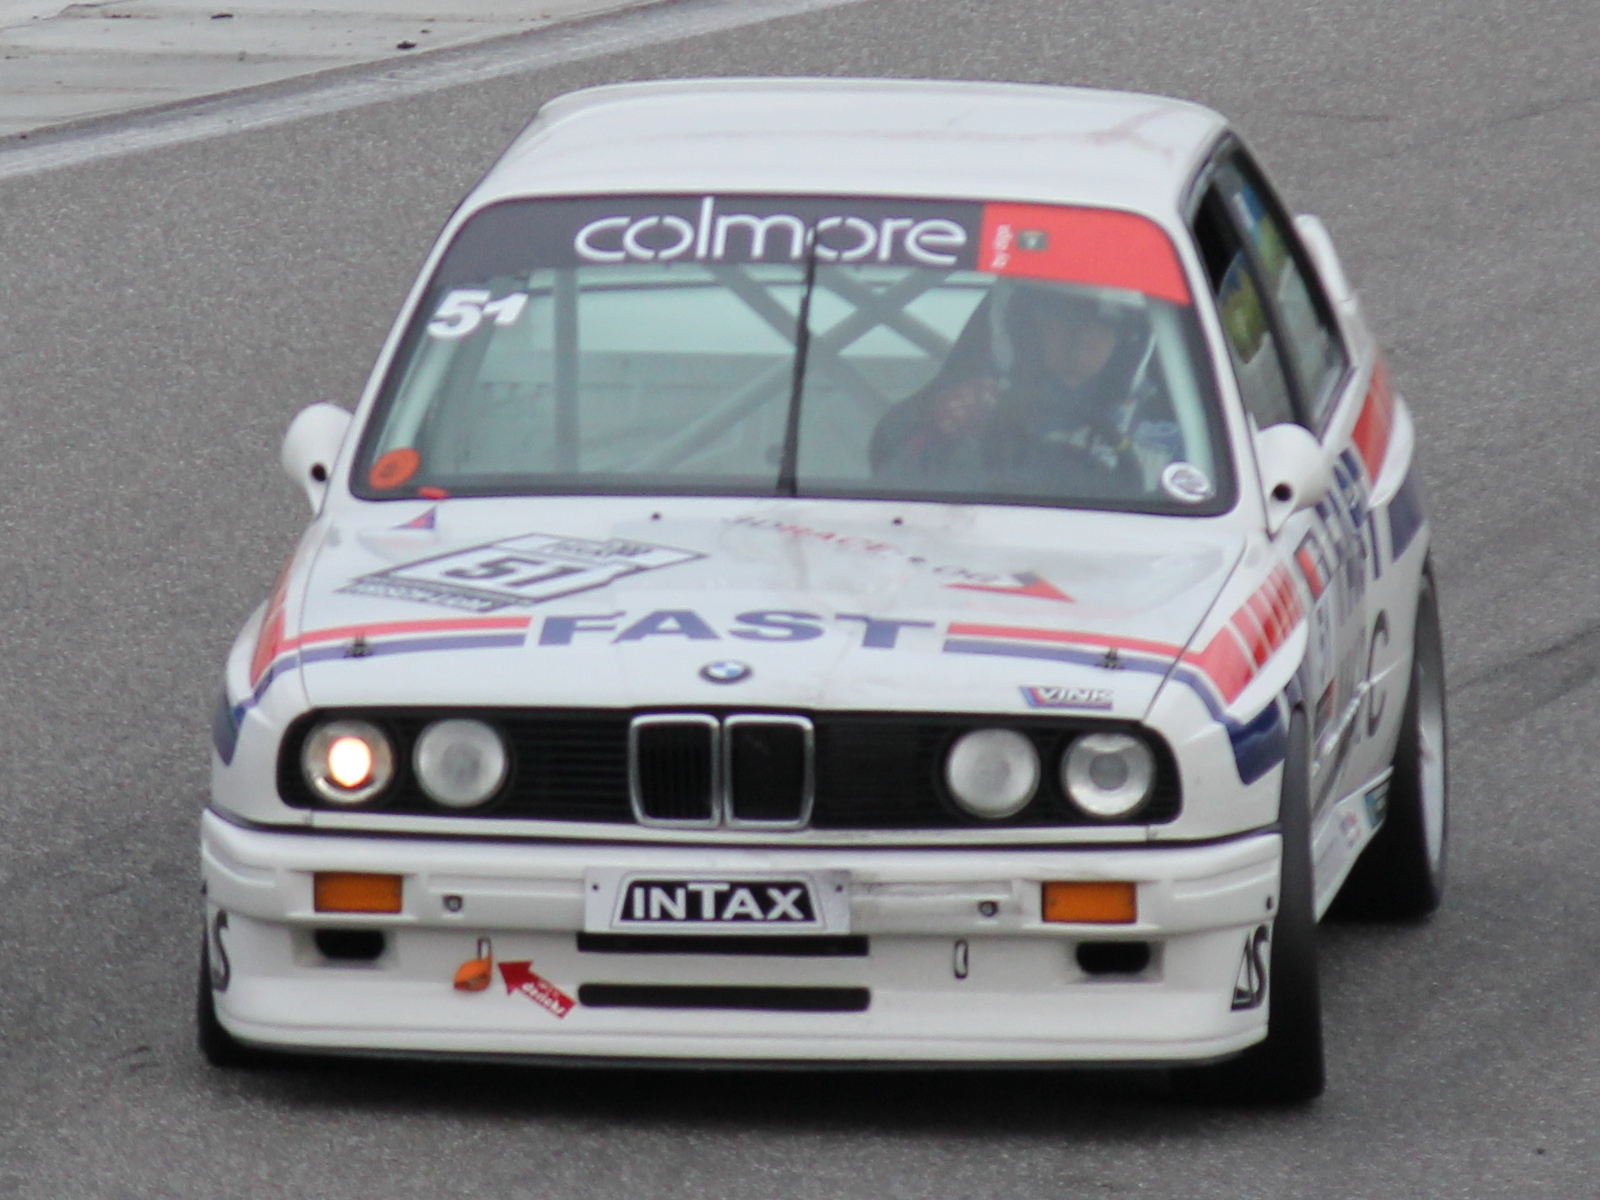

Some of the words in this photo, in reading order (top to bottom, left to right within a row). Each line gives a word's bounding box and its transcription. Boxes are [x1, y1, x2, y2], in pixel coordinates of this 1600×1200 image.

[574, 196, 967, 264] colmore
[427, 289, 529, 338] 51
[442, 555, 590, 588] 51
[538, 609, 936, 649] FAST
[633, 882, 804, 920] INTAX
